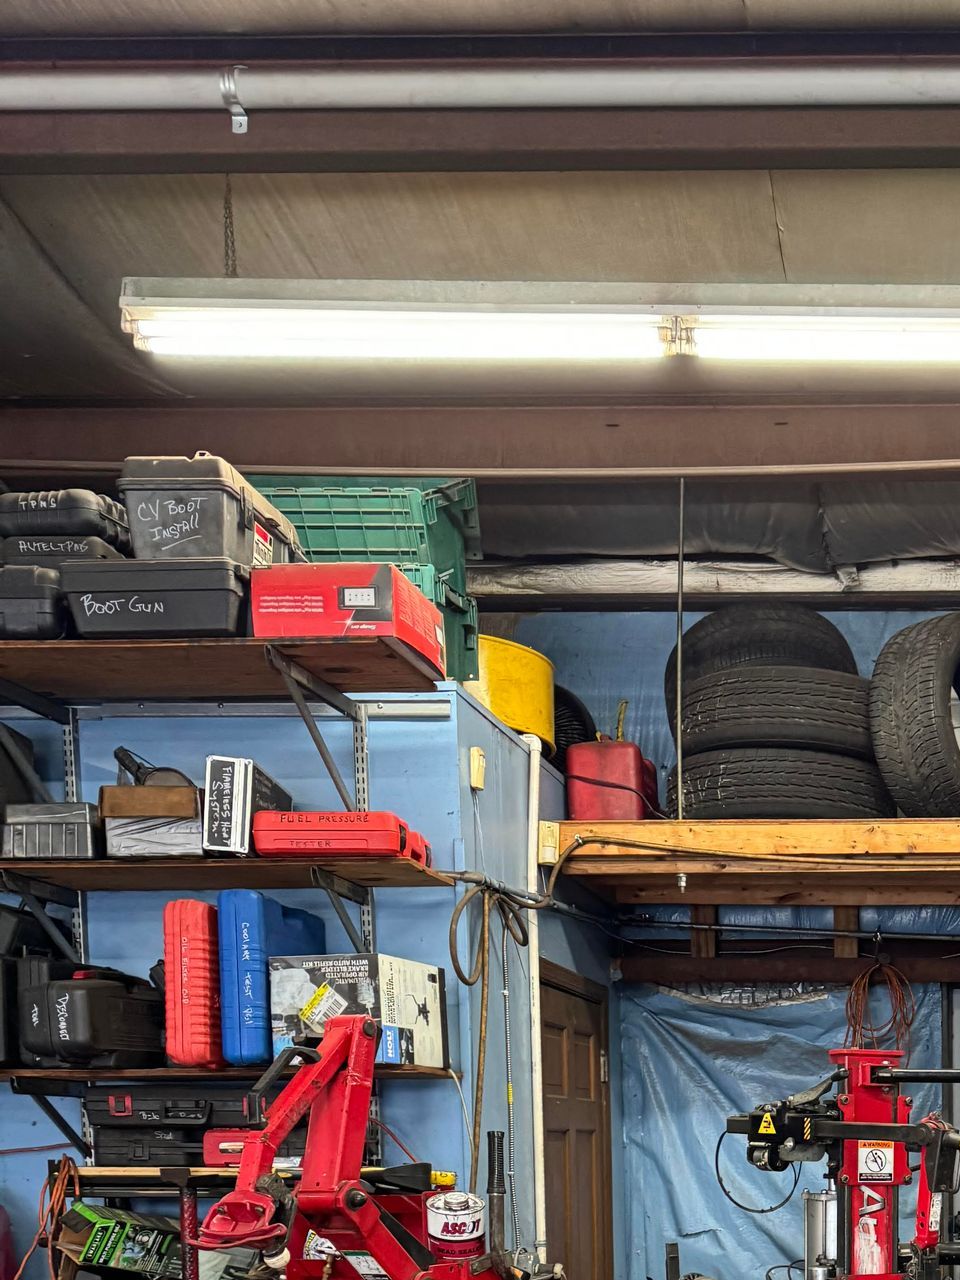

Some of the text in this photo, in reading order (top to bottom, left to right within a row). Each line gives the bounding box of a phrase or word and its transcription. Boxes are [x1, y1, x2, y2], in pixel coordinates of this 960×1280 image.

[137, 497, 209, 521] CV BOOT
[80, 593, 164, 616] BOOT GUN
[280, 813, 369, 823] FUEL PRESSURE
